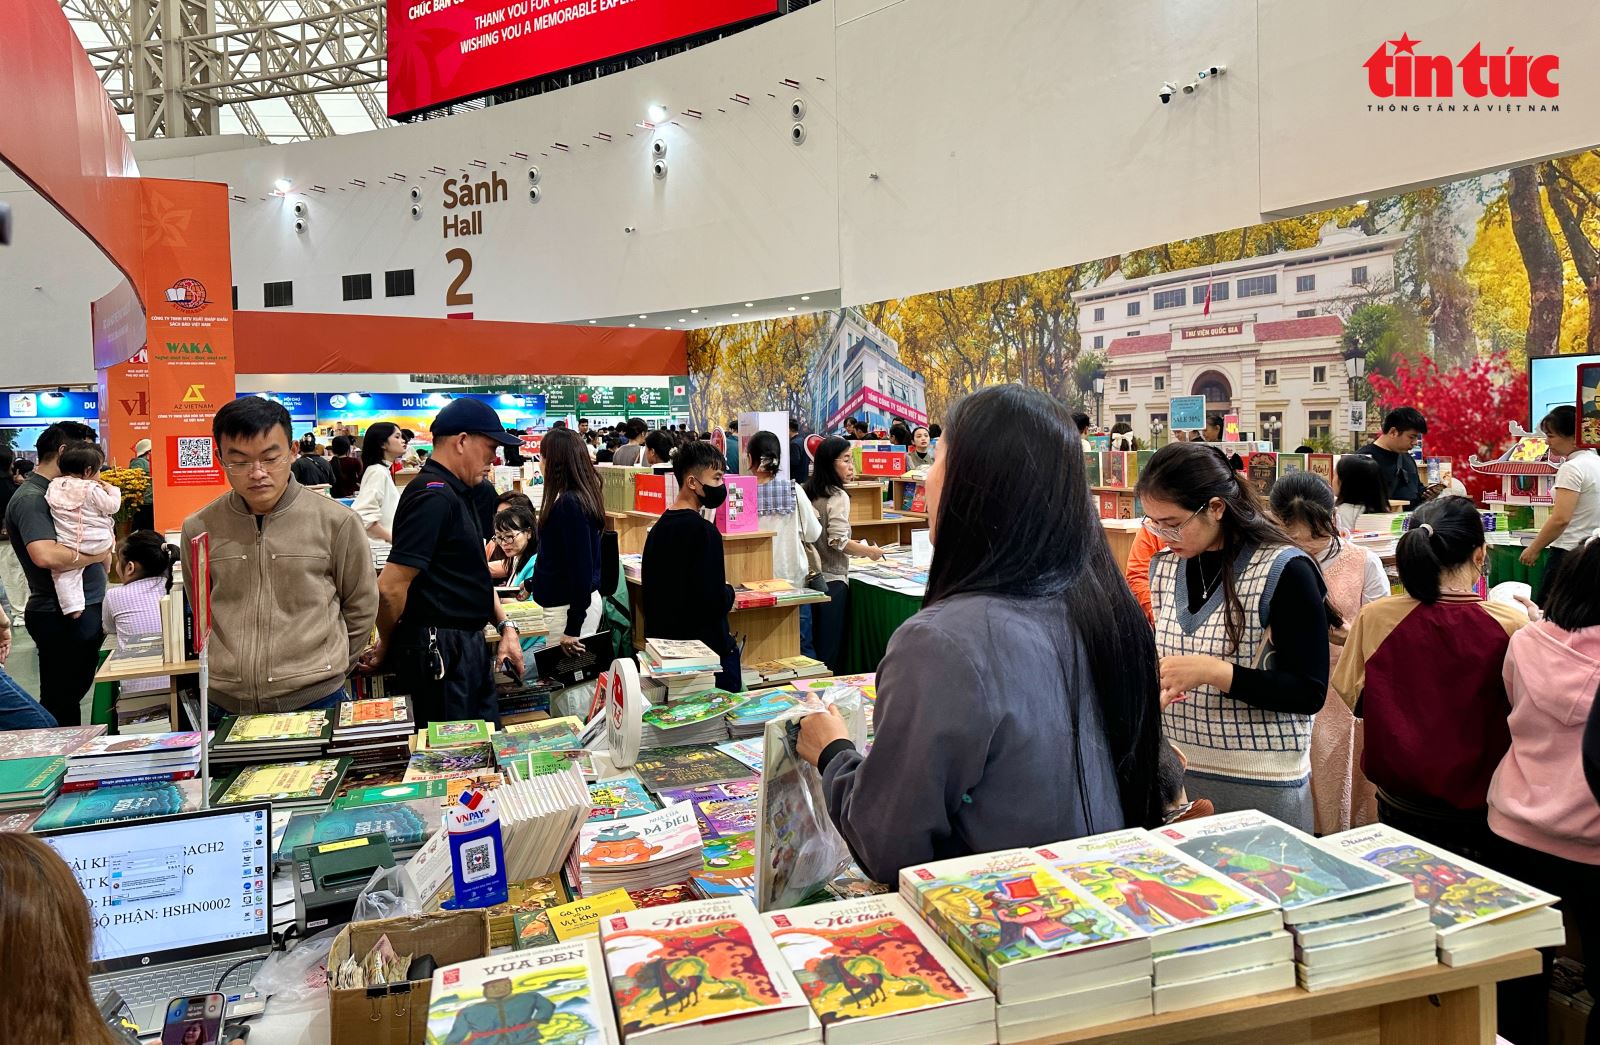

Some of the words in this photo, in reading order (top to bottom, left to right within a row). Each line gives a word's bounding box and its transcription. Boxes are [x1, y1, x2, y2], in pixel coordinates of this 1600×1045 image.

[408, 1, 431, 20] CHÚC
[474, 8, 505, 30] THANK
[507, 1, 528, 19] YOU
[460, 30, 499, 54] WISHING
[501, 23, 522, 41] YOU
[523, 20, 532, 35] A
[533, 0, 597, 31] MEMORABLE
[443, 171, 507, 209] Sảnh
[443, 210, 482, 238] Hall
[445, 248, 473, 306] 2
[1185, 329, 1197, 337] THƯ
[1197, 328, 1210, 336] VIỆN
[1210, 327, 1227, 336] QUỐC
[1227, 326, 1239, 334] GIA
[166, 342, 213, 354] WAKA
[83, 401, 96, 410] DU
[402, 398, 415, 407] DU
[456, 809, 484, 824] VNPAY
[114, 909, 158, 925] PHẬN:
[163, 897, 231, 918] HSHN0002
[671, 903, 733, 917] CHUYỆN
[483, 959, 535, 976] VUA
[538, 949, 585, 966] ĐEN
